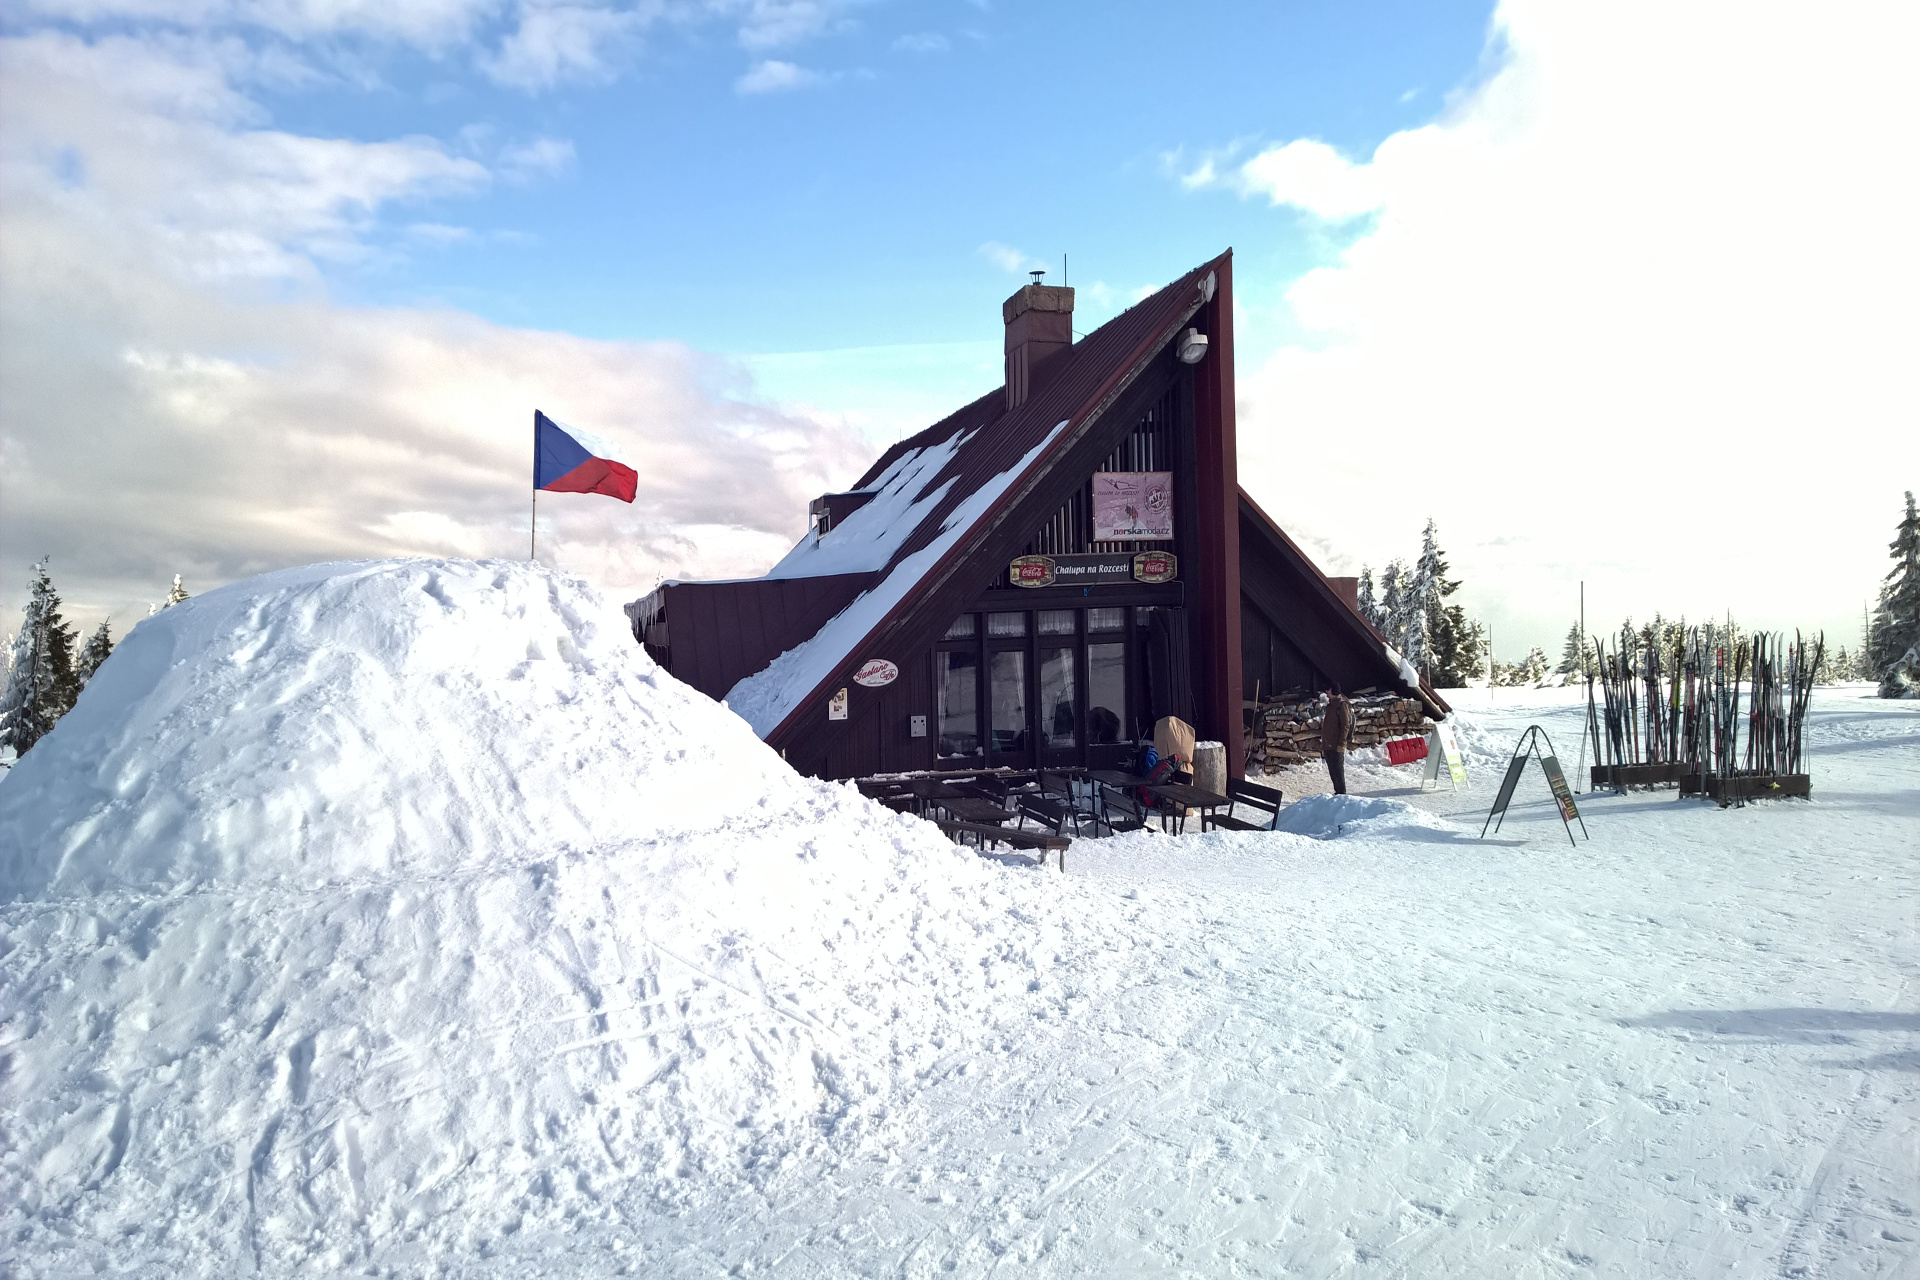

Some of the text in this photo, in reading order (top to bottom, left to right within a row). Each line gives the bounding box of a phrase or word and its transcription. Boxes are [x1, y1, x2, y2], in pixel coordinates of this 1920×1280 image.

[1055, 563, 1130, 575] Chalupa na Rozcestí
